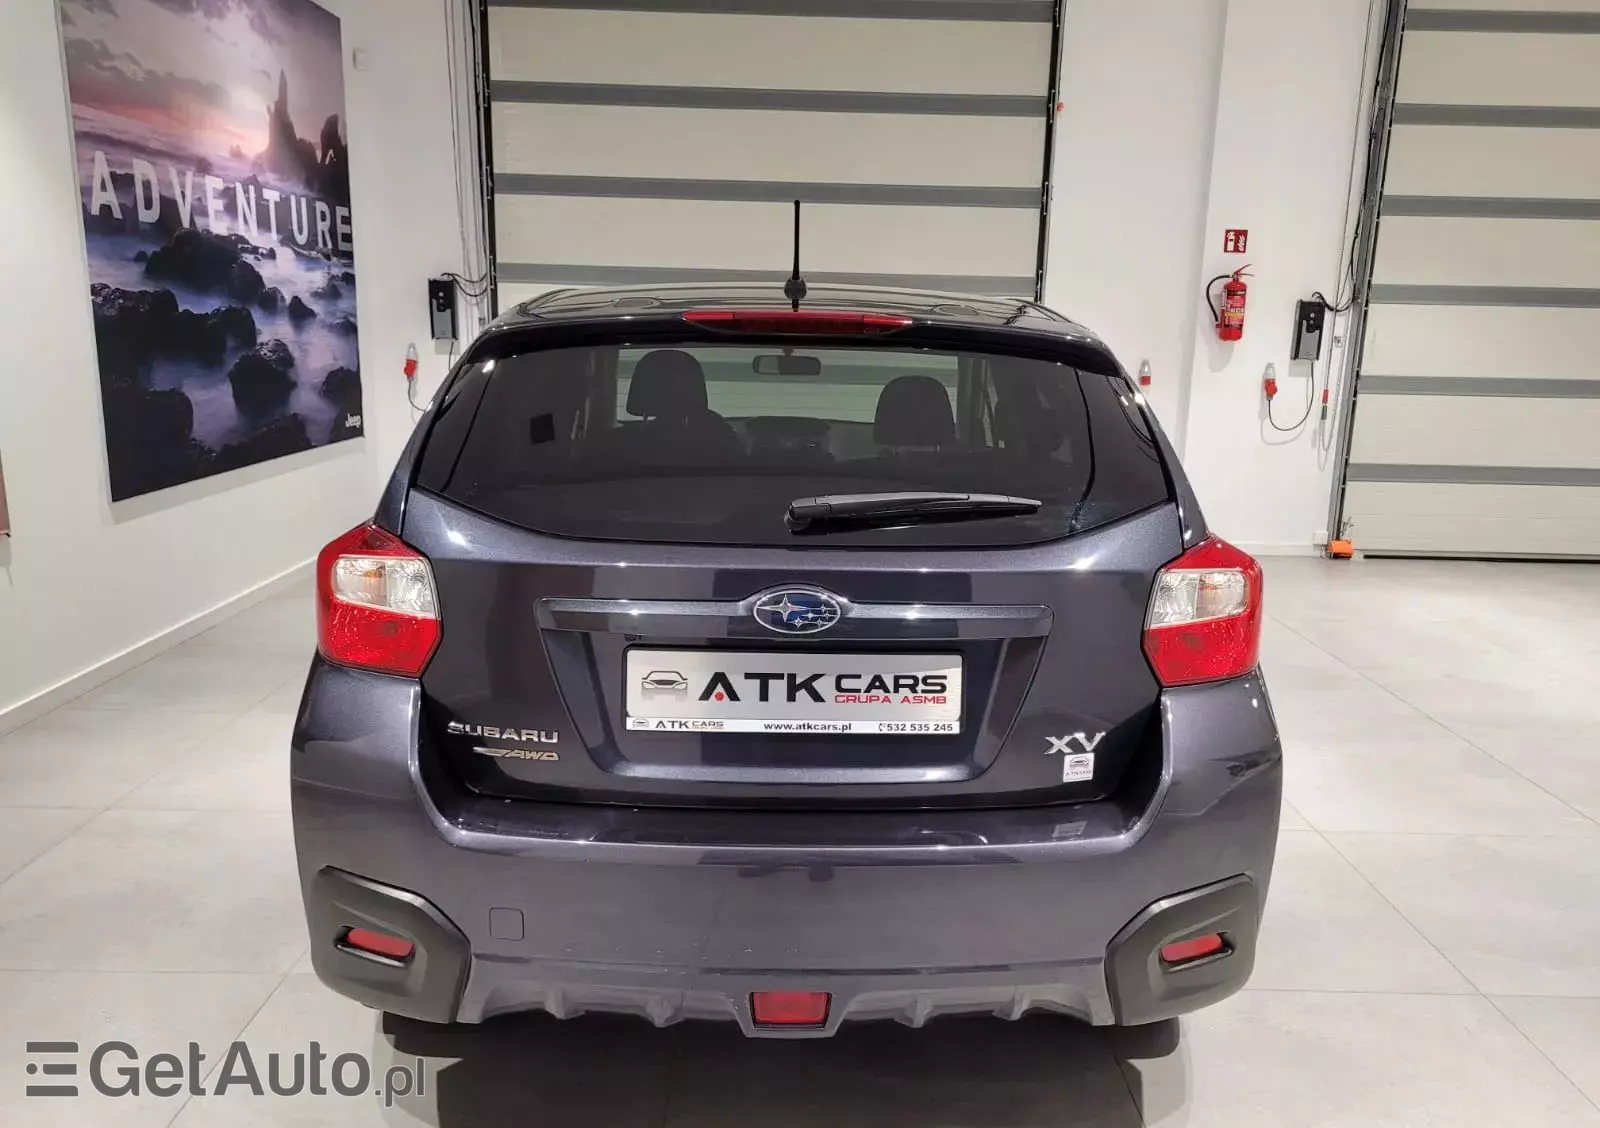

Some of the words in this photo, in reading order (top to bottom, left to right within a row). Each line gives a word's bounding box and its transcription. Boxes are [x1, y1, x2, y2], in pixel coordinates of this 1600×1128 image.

[90, 150, 353, 251] ADVENTURE
[345, 413, 361, 429] Jeep
[698, 671, 827, 703] ATK
[835, 674, 948, 694] CARS
[834, 695, 892, 704] GRUPA
[900, 695, 947, 704] ASMB
[655, 720, 690, 729] ATK
[691, 720, 725, 728] CARS
[763, 722, 852, 733] www.atkcars.pl
[887, 723, 907, 732] 532
[910, 723, 930, 732] 535
[934, 723, 954, 732] 245
[447, 720, 559, 744] SUBARU
[1043, 731, 1106, 755] XV
[504, 749, 560, 761] AWD
